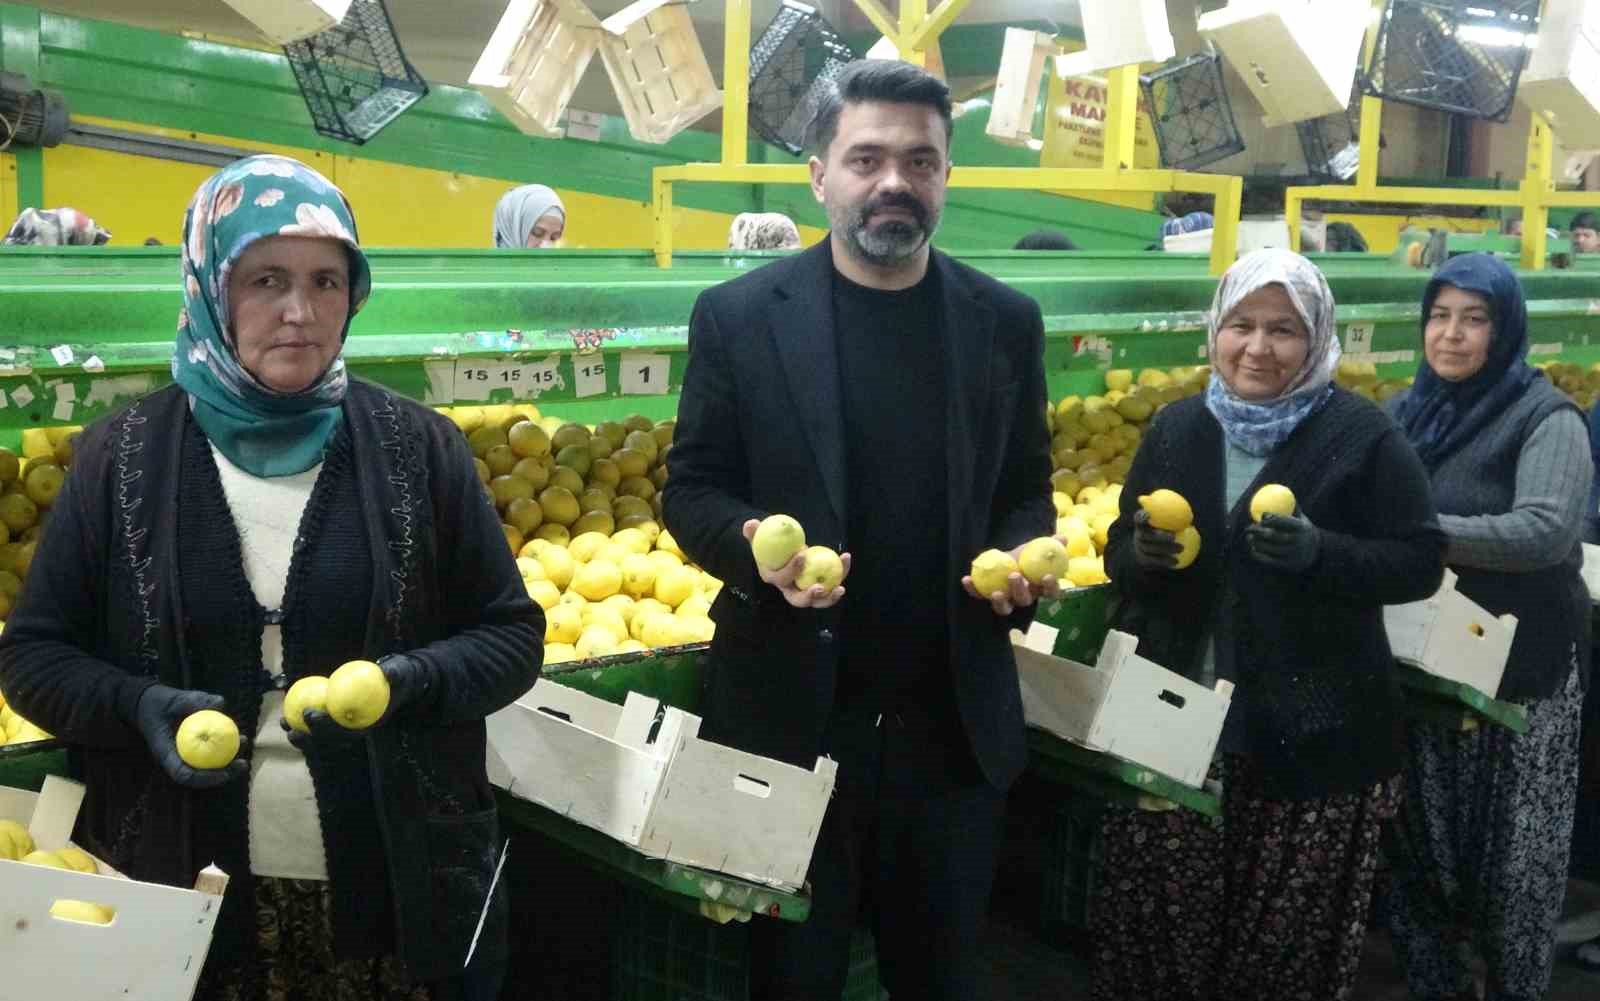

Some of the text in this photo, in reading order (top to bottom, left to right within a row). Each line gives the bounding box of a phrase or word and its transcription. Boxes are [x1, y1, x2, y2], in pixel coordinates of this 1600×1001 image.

[463, 369, 553, 383] 15 15 15
[581, 364, 605, 377] 15
[638, 366, 651, 383] 1
